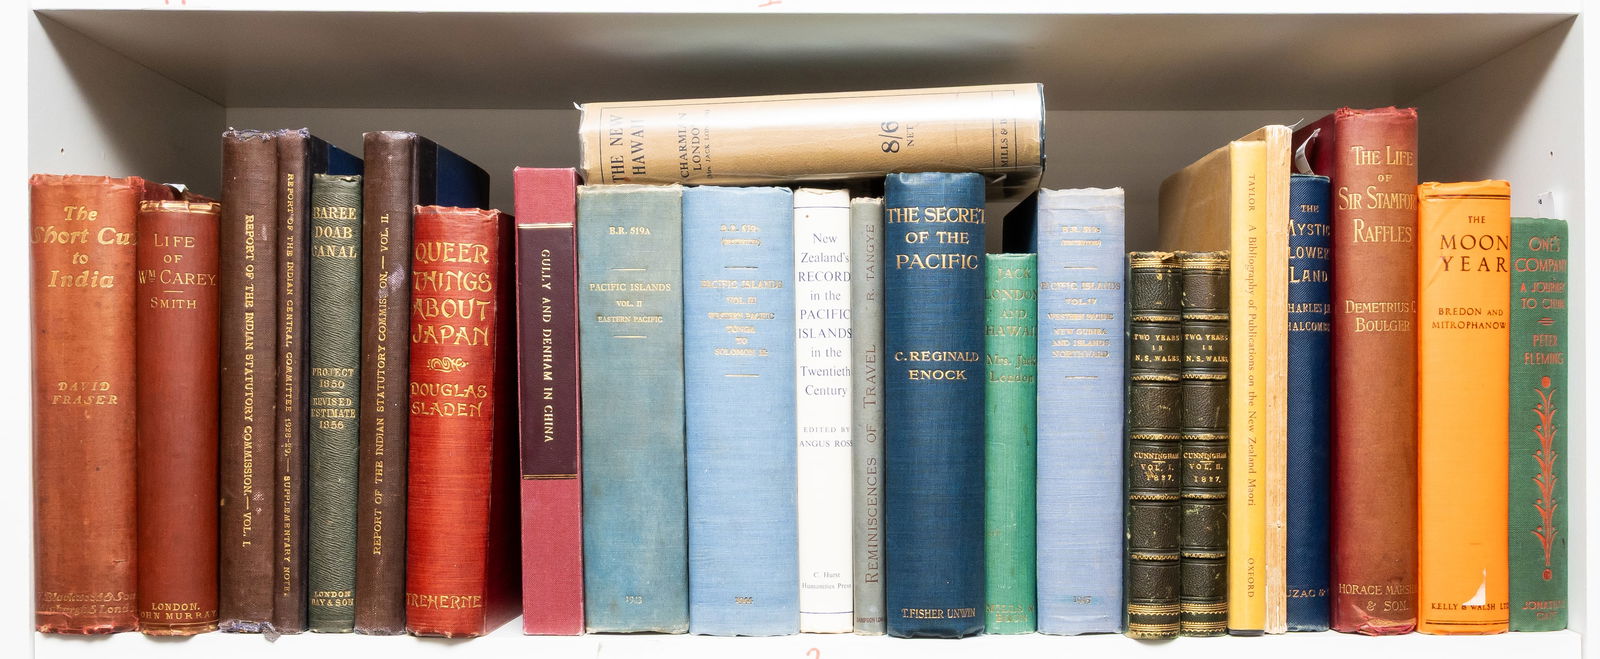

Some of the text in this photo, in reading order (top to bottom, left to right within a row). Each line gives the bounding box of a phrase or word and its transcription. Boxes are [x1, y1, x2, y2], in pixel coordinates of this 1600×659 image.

[878, 120, 903, 153] 8/6
[906, 126, 914, 146] NET
[1000, 128, 1008, 136] &
[1000, 138, 1008, 167] MILLS
[1352, 146, 1413, 165] THE LIFE
[610, 155, 625, 183] THE
[1378, 174, 1393, 182] OF
[1248, 175, 1256, 212] TAYLOR
[1339, 186, 1362, 211] SIR
[64, 206, 98, 221] The
[312, 206, 357, 220] BAREE
[886, 206, 986, 224] THE SECRET
[1300, 205, 1319, 213] THE
[287, 218, 294, 231] OF
[630, 226, 651, 235] 519A
[1353, 218, 1412, 243] RAFFLES
[31, 226, 89, 244] Short
[245, 215, 254, 261] REPORT
[315, 226, 353, 238] DOAB
[812, 232, 837, 243] New
[905, 231, 969, 244] OF THE
[154, 234, 195, 248] LIFE
[1440, 234, 1509, 250] MOON
[72, 252, 88, 265] to
[164, 254, 183, 264] OF
[416, 242, 490, 264] QUEER
[801, 252, 850, 263] Zealand's
[866, 224, 875, 301] R. TANGYE
[896, 254, 978, 270] PACIFIC
[1442, 256, 1508, 272] YEAR
[245, 264, 254, 280] OF
[286, 262, 294, 295] INDIAN
[798, 271, 852, 282] RECORD
[995, 268, 1031, 282] JACK
[1290, 266, 1328, 283] LAND
[48, 270, 114, 288] India
[414, 271, 493, 292] THINGS
[741, 280, 784, 288] ISLANDS
[589, 283, 671, 291] PACIFIC ISLANDS
[1520, 282, 1527, 292] A
[245, 283, 254, 308] THE
[810, 290, 841, 301] in the
[985, 289, 1037, 300] LONDON
[150, 297, 196, 309] SMITH
[413, 298, 490, 320] ABOUT
[1345, 300, 1409, 314] DEMETRIUS
[1520, 298, 1537, 309] TO
[800, 309, 850, 320] PACIFIC
[1000, 310, 1028, 319] AND
[1438, 307, 1482, 316] BREDON
[286, 300, 294, 347] CENTRAL
[597, 315, 663, 323] EASTERN PACIFIC
[1355, 317, 1410, 332] BOULGER
[1432, 321, 1506, 330] MITROPHANOW
[245, 313, 254, 350] INDIAN
[413, 324, 489, 346] JAPAN
[798, 328, 852, 338] ISLANDS
[541, 249, 554, 442] GULLY AND DENHAM IN CHINA
[1533, 334, 1557, 347] PETER
[811, 347, 842, 358] in the
[1524, 352, 1564, 365] FLEMING
[800, 366, 851, 376] Twentieth
[1246, 224, 1257, 506] A Bibliography of Publications on the New Zealand Maori
[312, 367, 355, 377] PROJECT
[377, 345, 386, 412] STATUTORY
[908, 370, 967, 380] ENOCK
[989, 370, 1035, 383] London
[58, 382, 110, 391] DAVID
[244, 354, 254, 422] STATUTORY
[285, 351, 293, 412] COMMITTEE
[320, 379, 346, 389] 1850
[410, 382, 488, 398] DOUGLAS
[805, 385, 847, 397] Century
[51, 394, 118, 405] FRASER
[312, 397, 352, 406] REVISED
[411, 402, 482, 417] SLADEN
[376, 418, 385, 456] INDIAN
[1134, 452, 1179, 460] CUNNINGHAM
[863, 345, 879, 583] REMINISCENCES OF TRAVEL
[1189, 463, 1212, 471] VOL.
[375, 460, 384, 483] THE
[375, 490, 384, 505] OF
[373, 509, 384, 555] REPORT
[1338, 584, 1382, 595] HORACE
[152, 602, 200, 610] LONDON.
[335, 598, 354, 607] SON
[406, 593, 481, 610] TREHERNE
[1367, 600, 1376, 612] &
[166, 610, 216, 620] MURRAY
[947, 608, 976, 618] UNWIN
